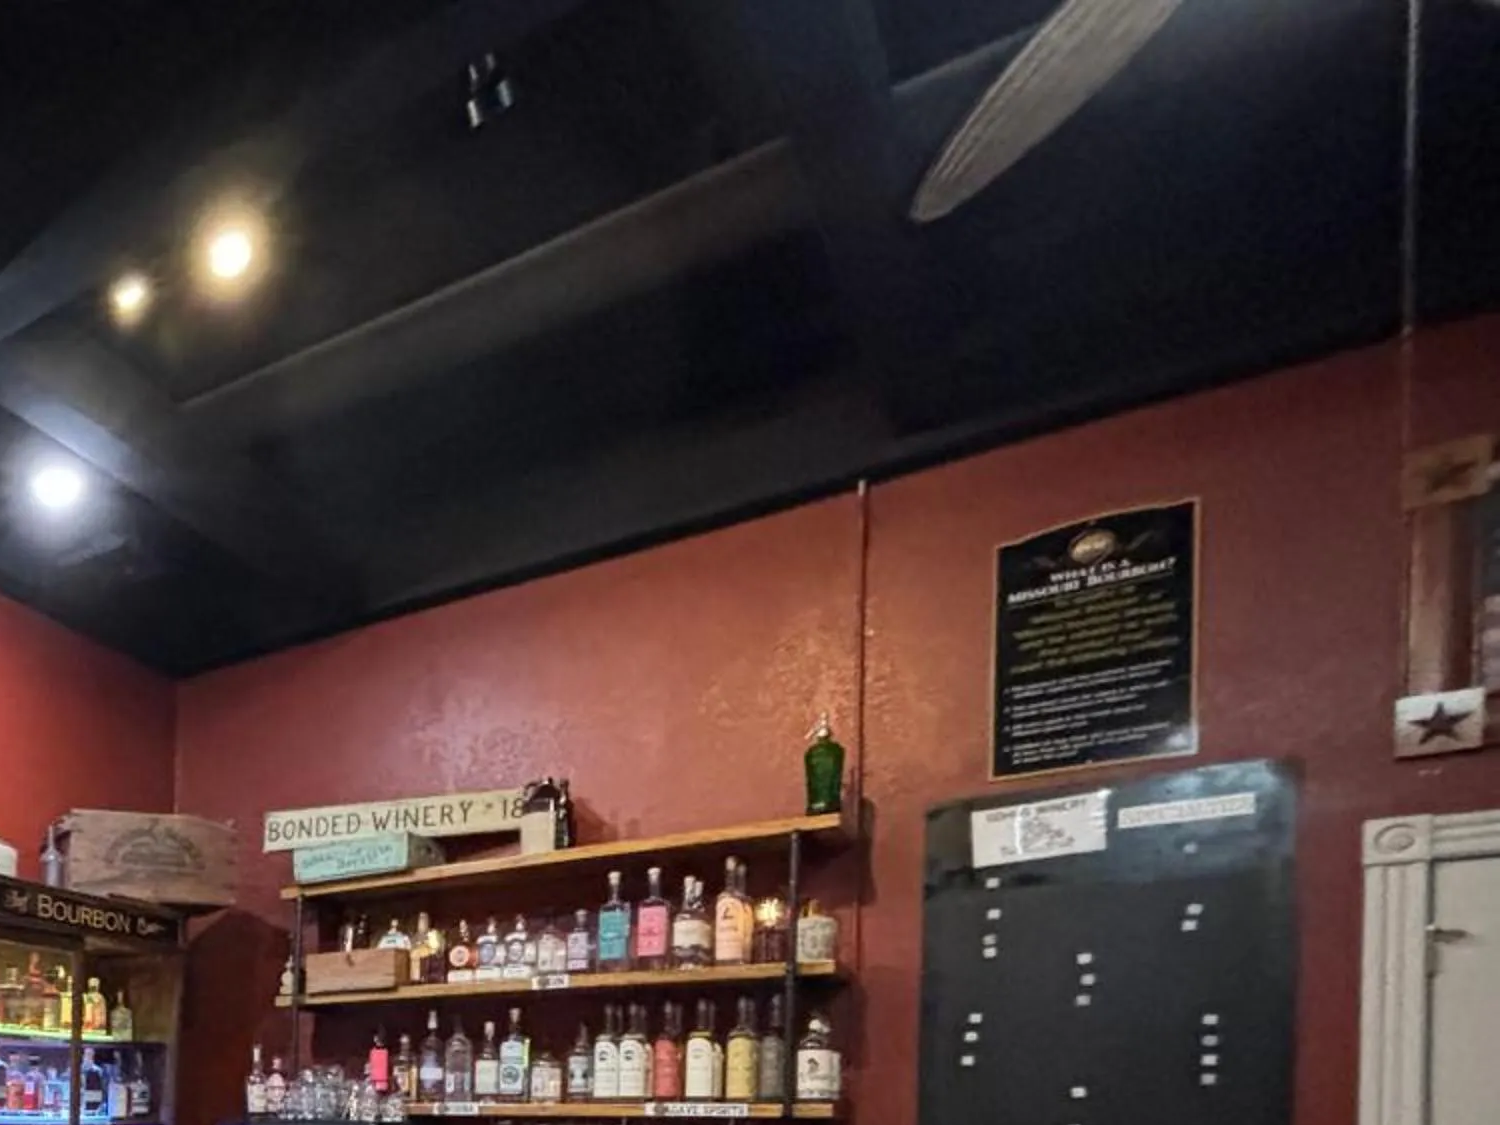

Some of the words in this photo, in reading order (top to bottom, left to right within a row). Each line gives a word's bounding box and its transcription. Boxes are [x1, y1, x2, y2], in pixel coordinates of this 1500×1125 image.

[267, 812, 361, 843] BONDED
[371, 800, 475, 832] WINERY
[37, 894, 132, 933] BOURBON
